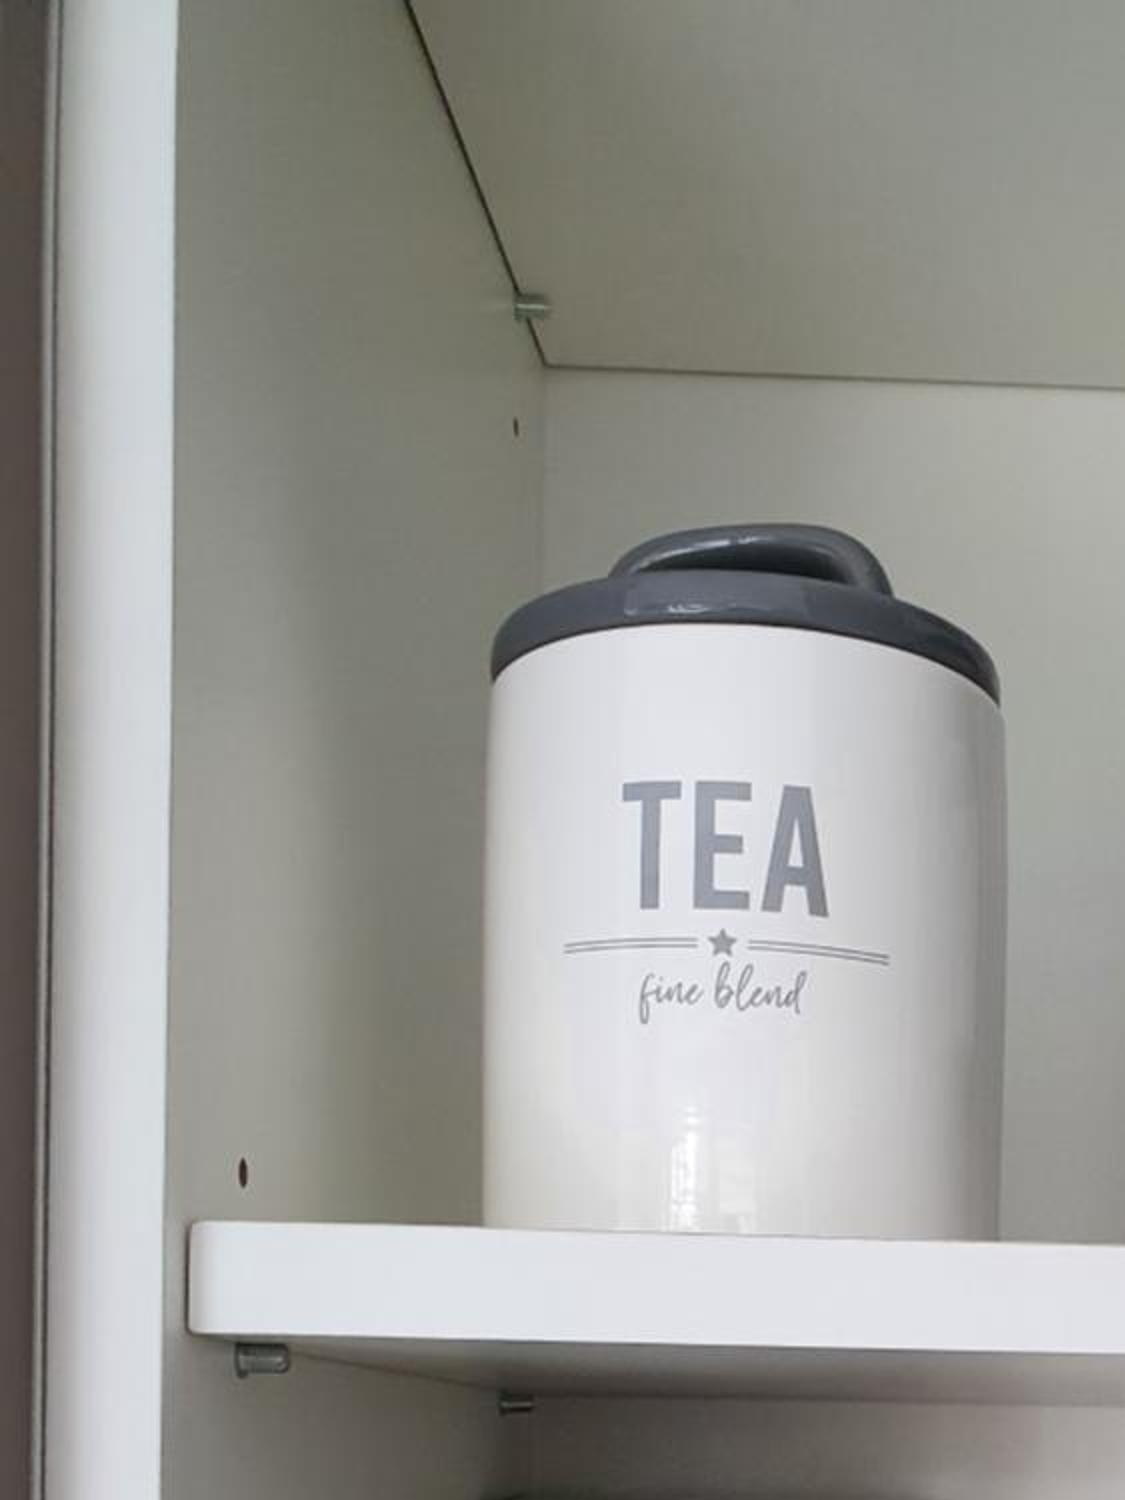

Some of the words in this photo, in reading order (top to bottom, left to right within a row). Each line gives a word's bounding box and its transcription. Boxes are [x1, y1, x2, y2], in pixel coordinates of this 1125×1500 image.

[622, 780, 829, 918] TEA
[639, 974, 703, 1024] fine
[714, 961, 807, 1014] blend
